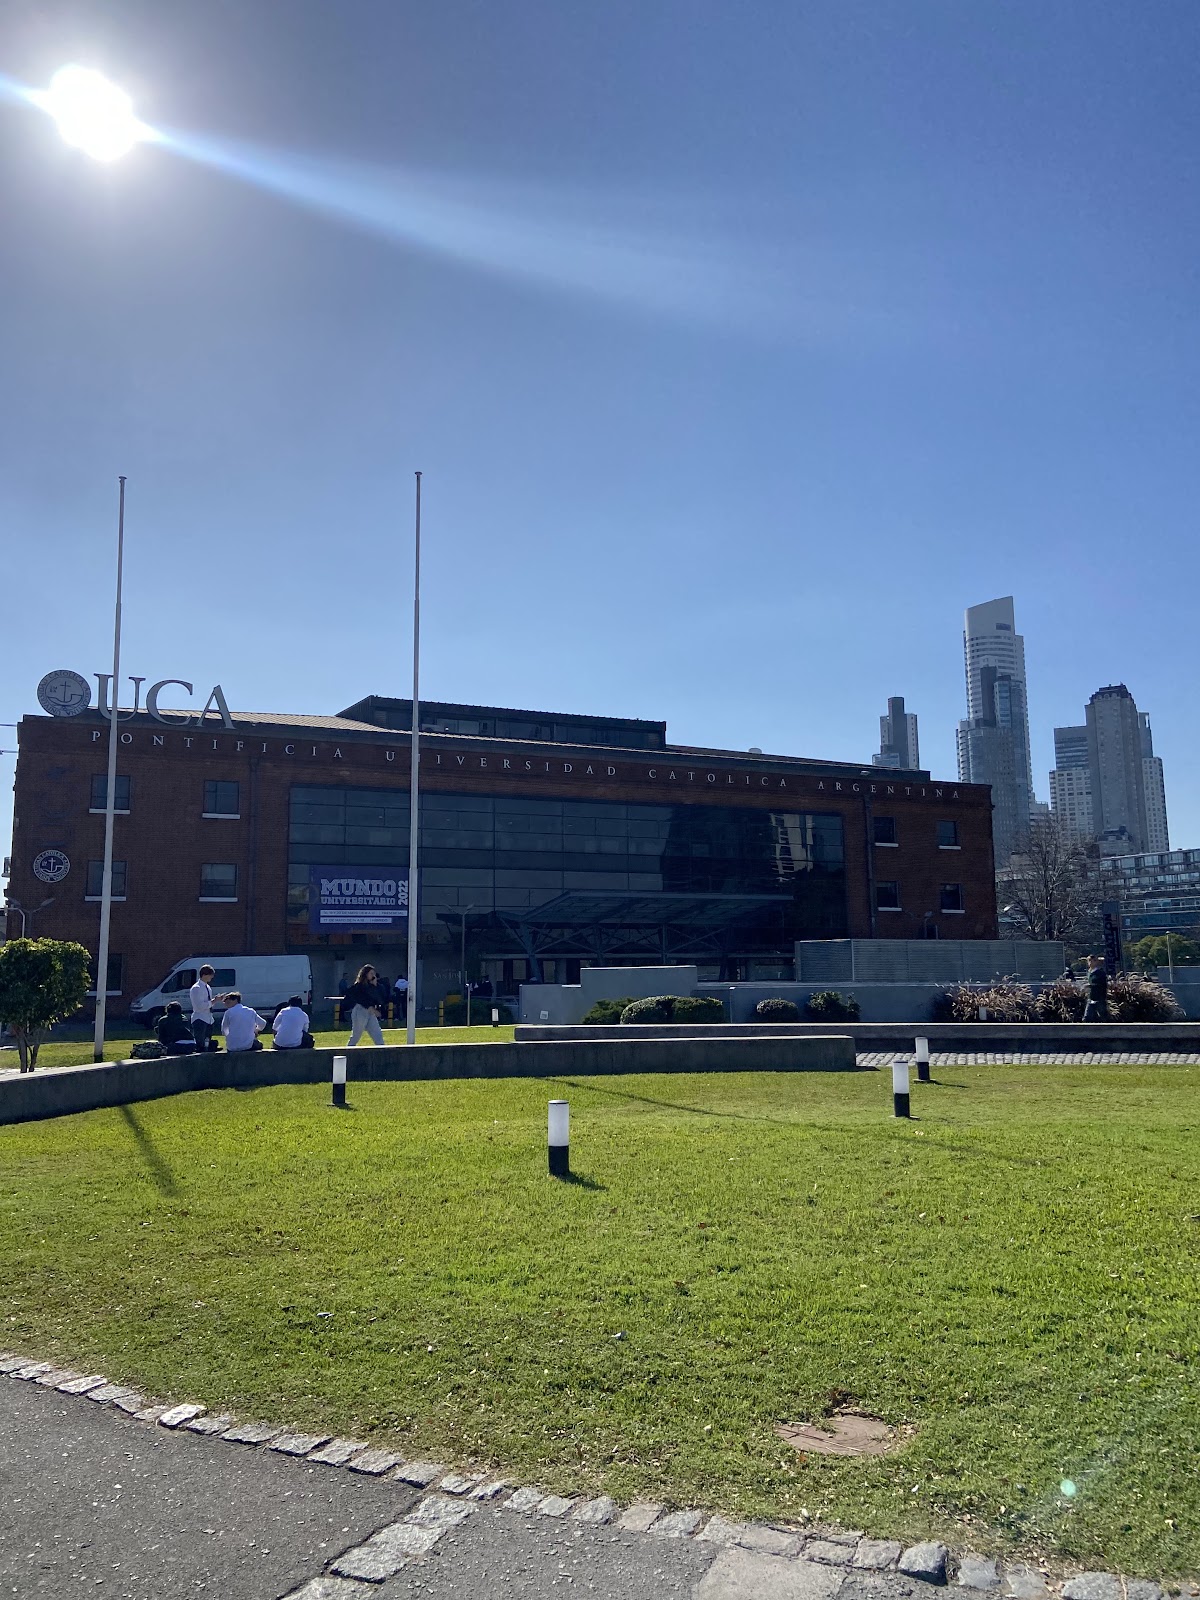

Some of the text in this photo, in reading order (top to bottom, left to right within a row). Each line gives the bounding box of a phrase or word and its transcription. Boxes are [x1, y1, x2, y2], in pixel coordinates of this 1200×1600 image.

[94, 673, 236, 729] UCA
[92, 731, 959, 799] PONTIFICIA UIVERSIDAD CATOLICA ARGENTINA
[320, 879, 396, 896] MUNDO
[320, 896, 396, 905] UNIVERSITARIO
[397, 880, 408, 906] 2022
